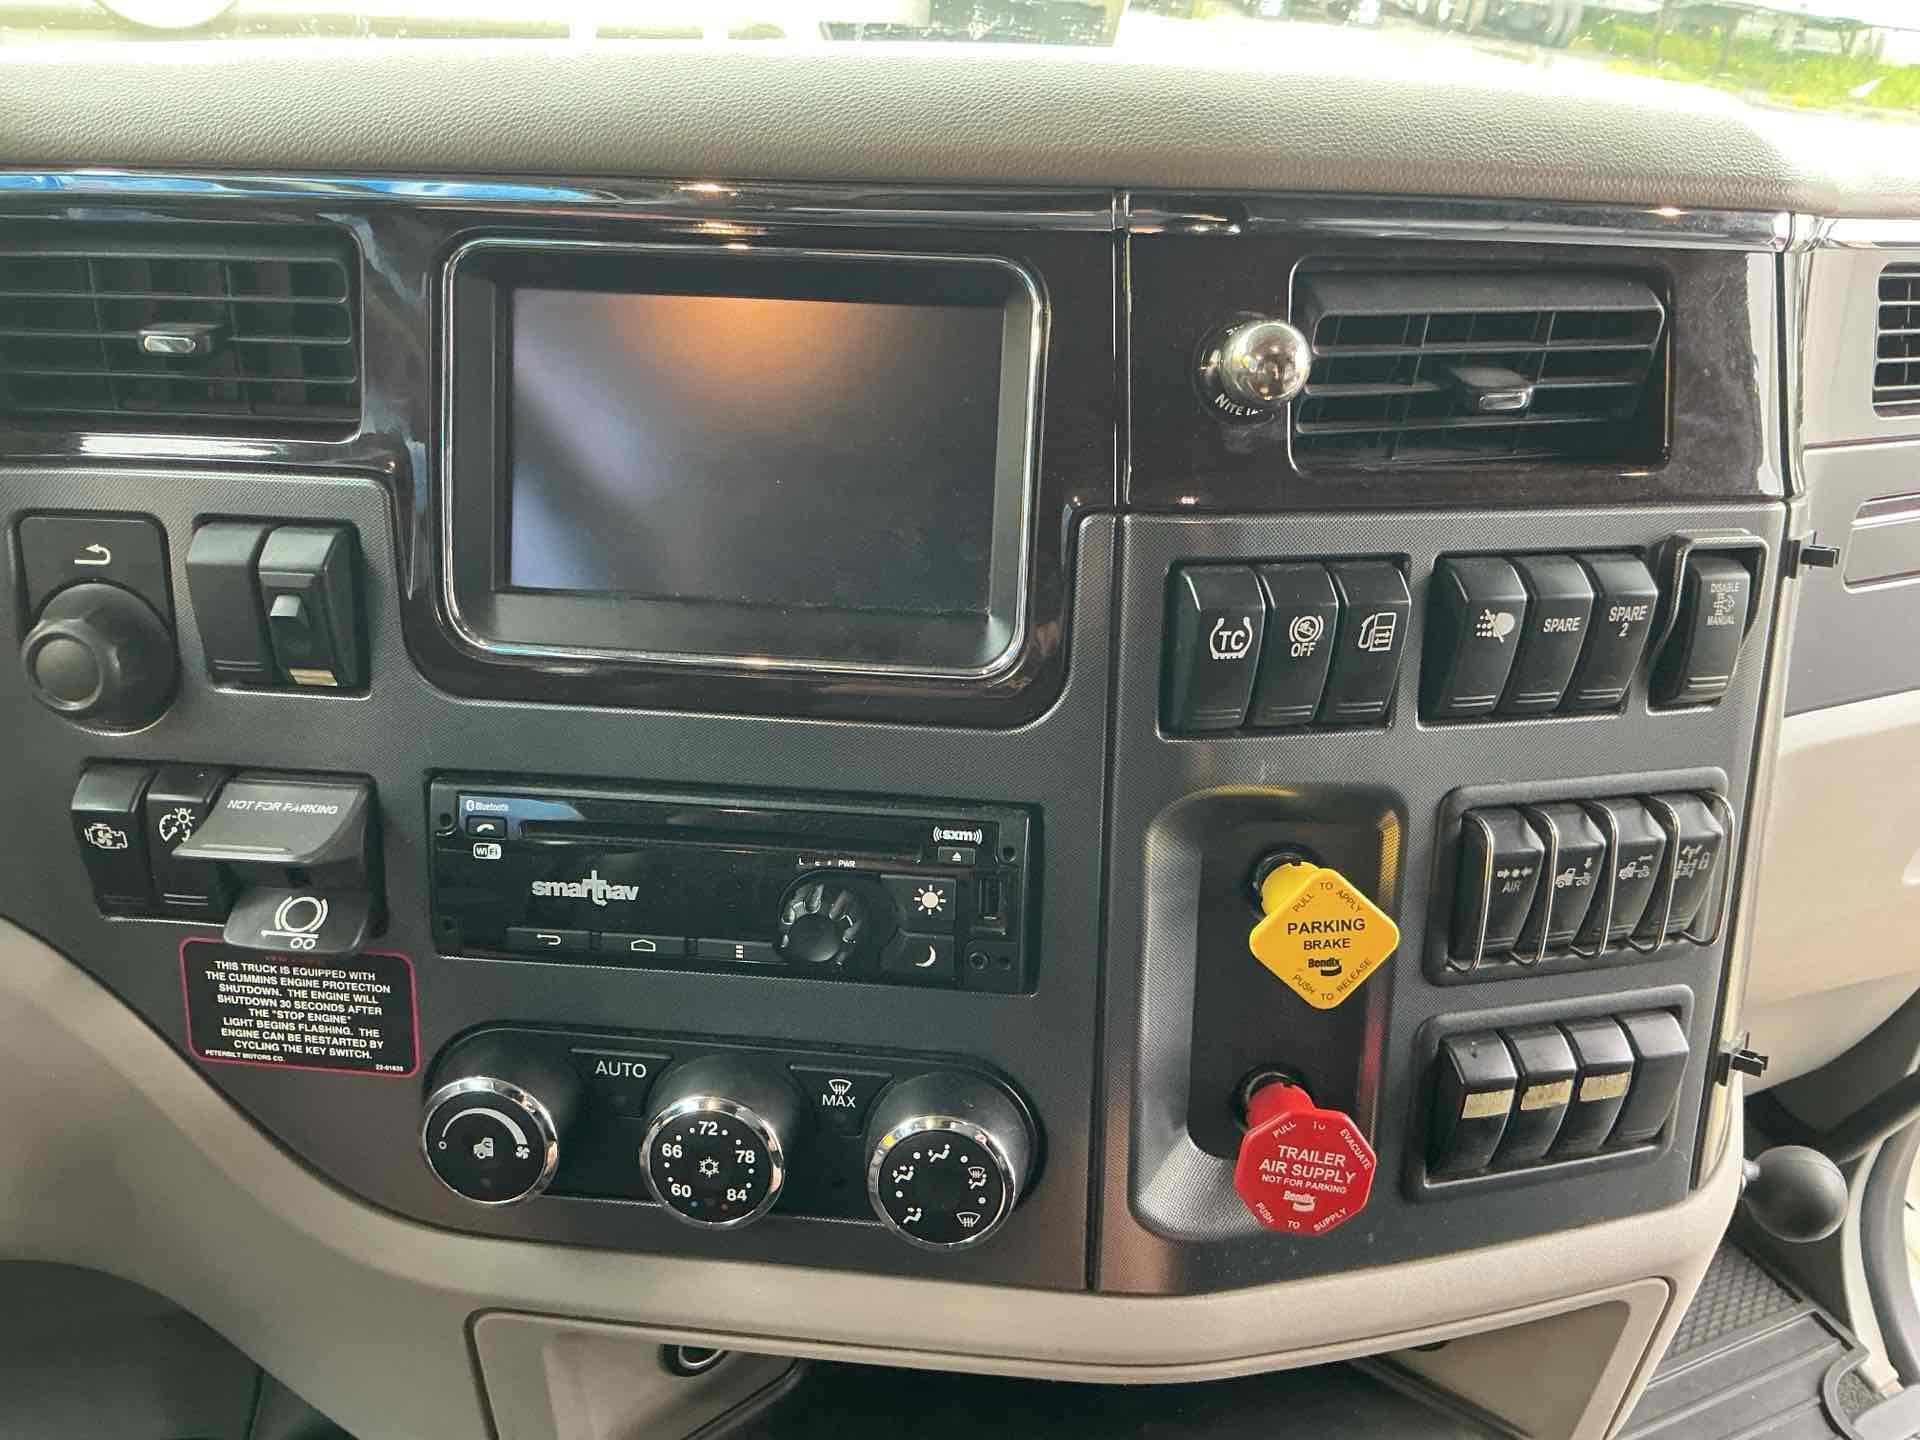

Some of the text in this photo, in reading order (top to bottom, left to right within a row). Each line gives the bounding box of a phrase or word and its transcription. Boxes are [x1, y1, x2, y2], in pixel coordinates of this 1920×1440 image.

[1608, 605, 1648, 622] SPARE
[1543, 617, 1582, 633] SPARE
[1618, 622, 1628, 637] 2
[1219, 631, 1246, 650] TC
[1291, 643, 1316, 657] OFF
[227, 800, 338, 815] NOT FOR PARKING
[838, 859, 856, 868] PWR
[1502, 881, 1521, 893] AIR
[1292, 881, 1362, 913] PULL TO APPLY
[1287, 918, 1366, 935] PARKING
[1303, 938, 1351, 950] BRAKE
[214, 960, 376, 981] THIS TRUCK IS EQUIPPED WITH
[1308, 957, 1340, 969] Bendix
[206, 971, 391, 994] THE CUMMINS ENGINE PROTECTION
[1292, 957, 1372, 1001] PUSH TO RELEASE
[219, 984, 379, 1004] SHUTDOWN. THE ENGINE WILL
[217, 994, 383, 1016] SHUTDOWN 30 SECONDS AFTER
[248, 1008, 269, 1018] THE
[272, 1010, 305, 1020] "STOP
[223, 1017, 380, 1038] LIGHT BEGINS FLASHING. THE
[221, 1028, 384, 1049] ENGINE CAN BE RESTARTED BY
[233, 1040, 373, 1060] CYCLING THE KEY SWITCH.
[242, 1052, 271, 1061] MOTORS
[595, 1060, 647, 1078] AUTO
[822, 1094, 856, 1108] MAX
[698, 1121, 718, 1136] 72
[662, 1143, 682, 1158] 66
[1272, 1120, 1372, 1170] PULL TO EVACUATE
[736, 1150, 756, 1164] 78
[1278, 1145, 1346, 1168] TRAILER
[1259, 1158, 1357, 1185] AIR SUPPLY
[671, 1183, 692, 1198] 60
[1262, 1174, 1347, 1194] NOT FOR PARKING
[726, 1188, 747, 1202] 84
[1256, 1201, 1348, 1232] PUSH TO SUPPLY
